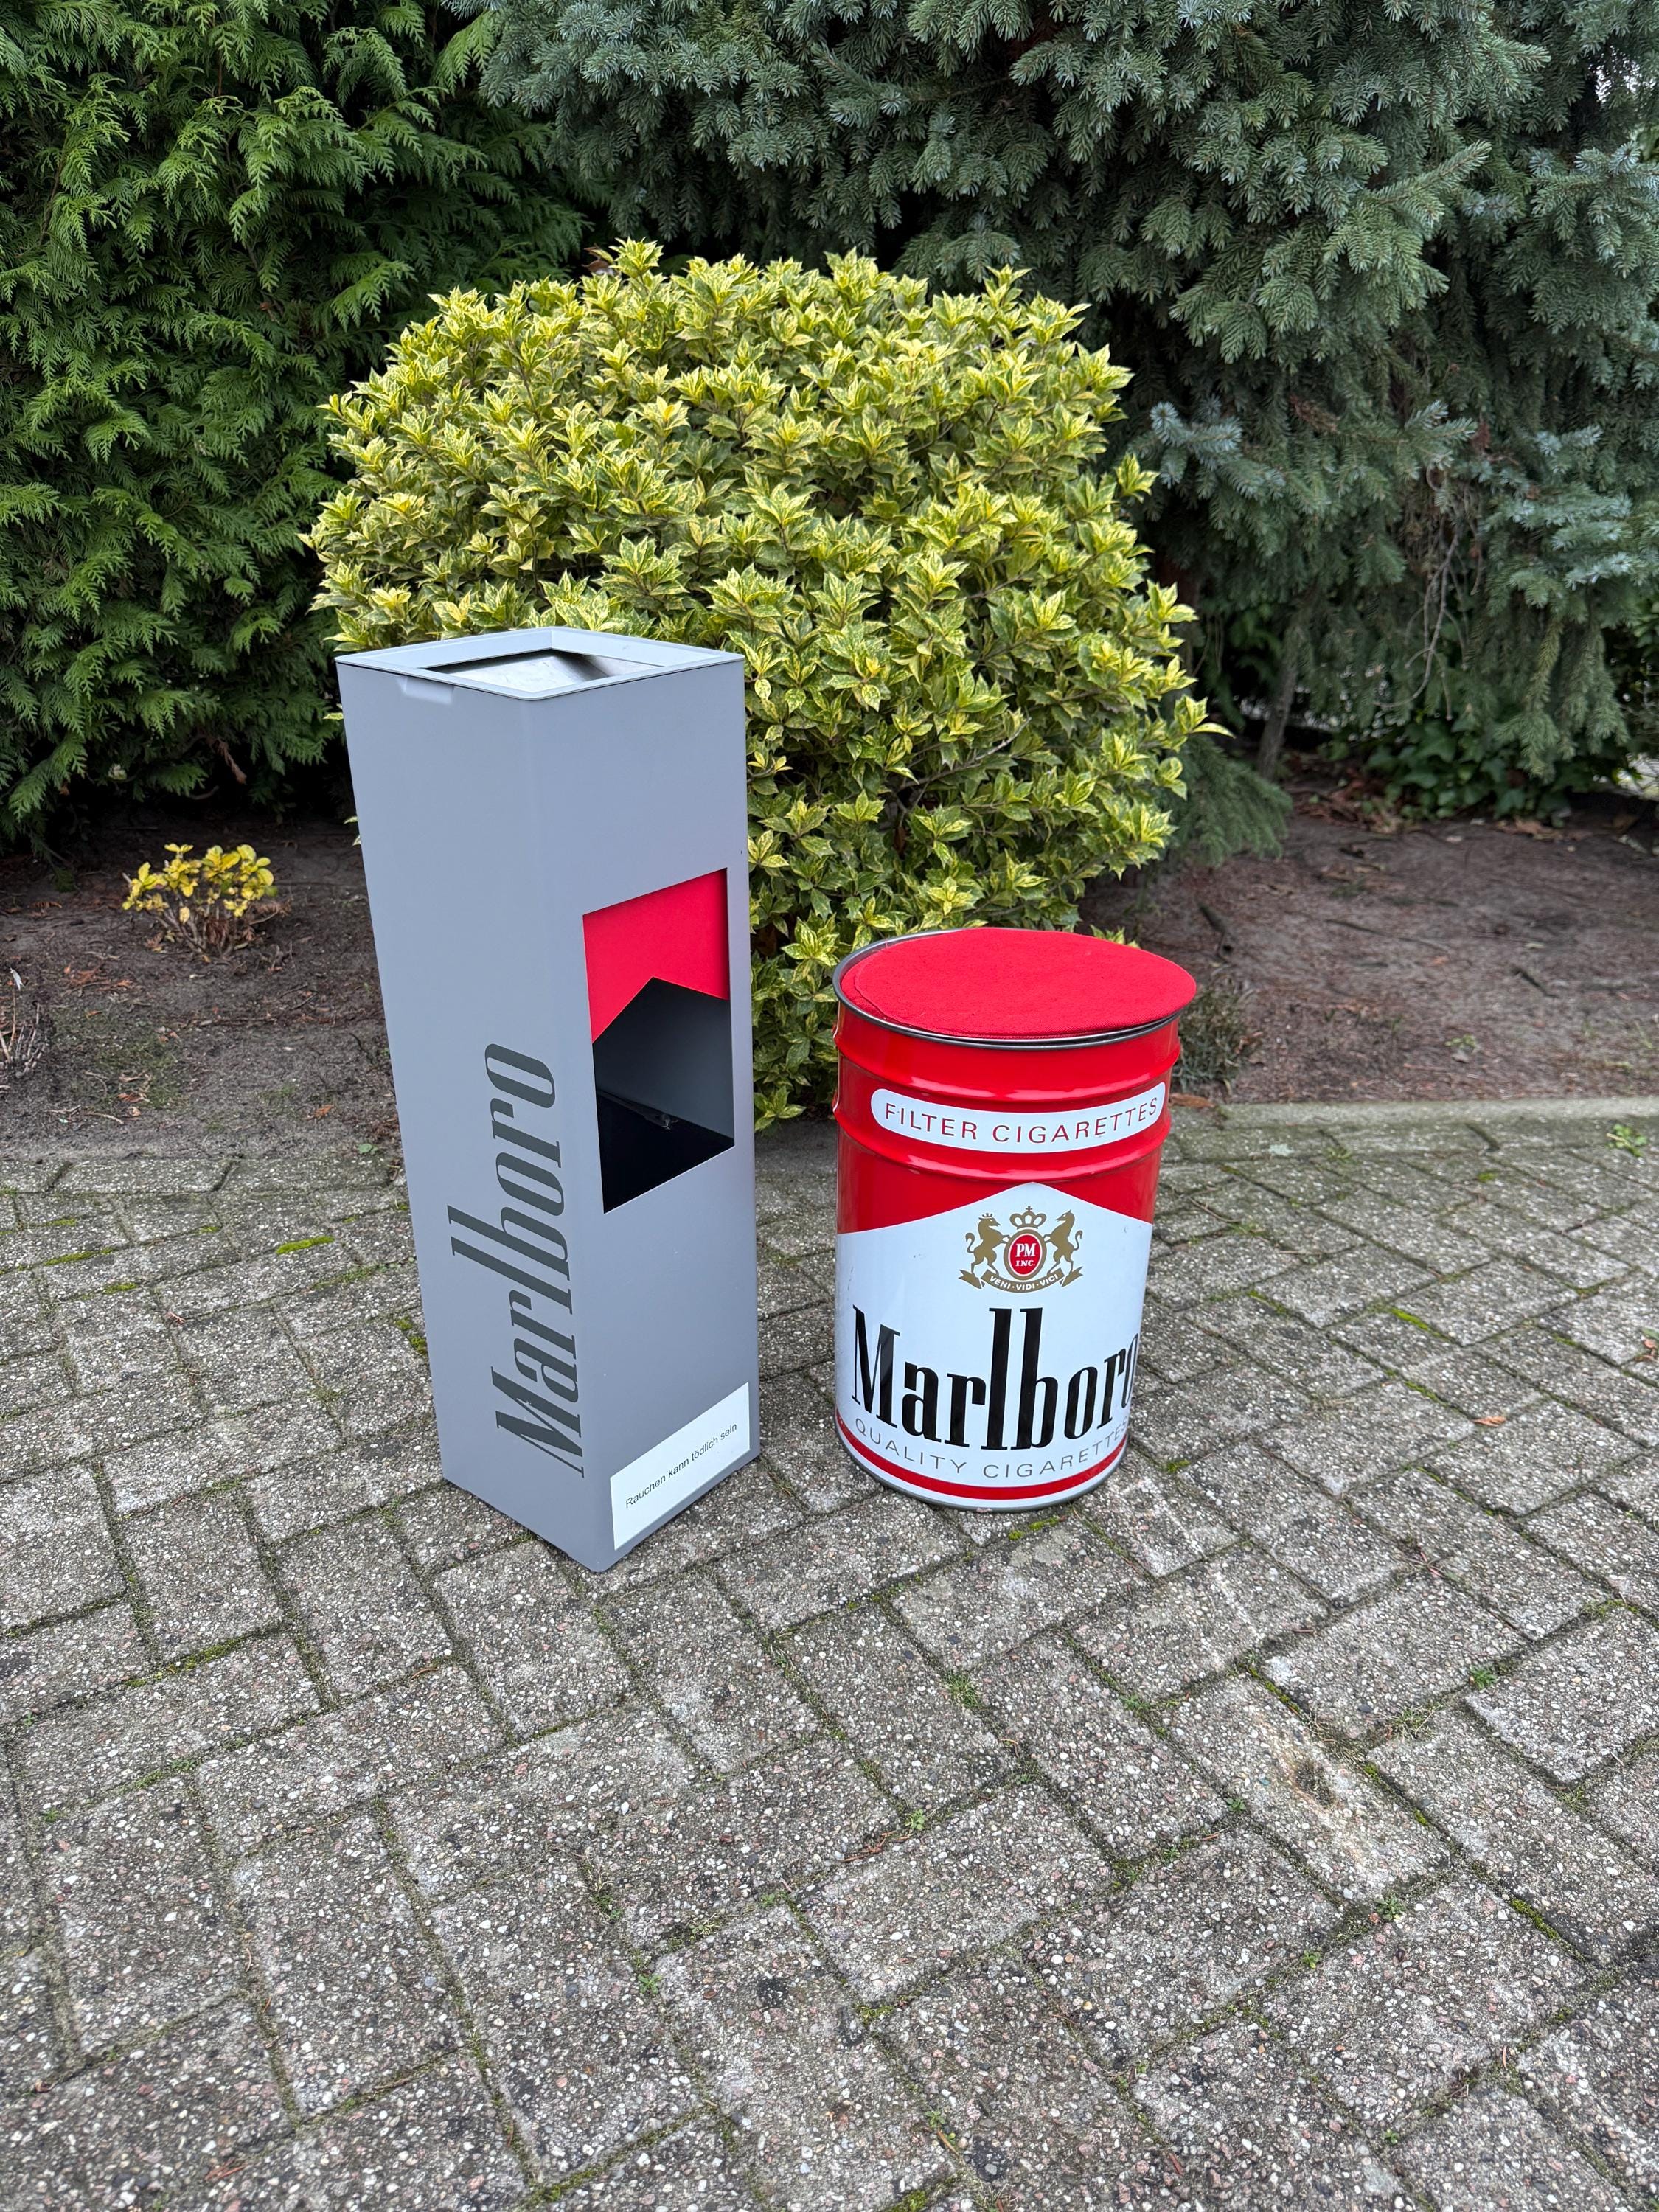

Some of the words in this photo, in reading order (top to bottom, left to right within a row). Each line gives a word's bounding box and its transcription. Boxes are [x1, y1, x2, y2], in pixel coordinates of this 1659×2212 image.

[885, 1103, 978, 1140] FILTER
[992, 1097, 1158, 1144] CIGARETTES
[447, 1043, 585, 1478] Marlboro
[1015, 1243, 1036, 1257] PM
[990, 1276, 1011, 1289] VENI
[1039, 1274, 1059, 1287] VICI
[852, 1304, 1138, 1450] Marlboro
[626, 1475, 666, 1509] Rauchen
[668, 1458, 689, 1478] kann
[691, 1437, 718, 1461] tödlich
[720, 1423, 737, 1440] sein
[855, 1417, 967, 1474] QUALITY
[983, 1416, 1127, 1478] CIGARETTES
